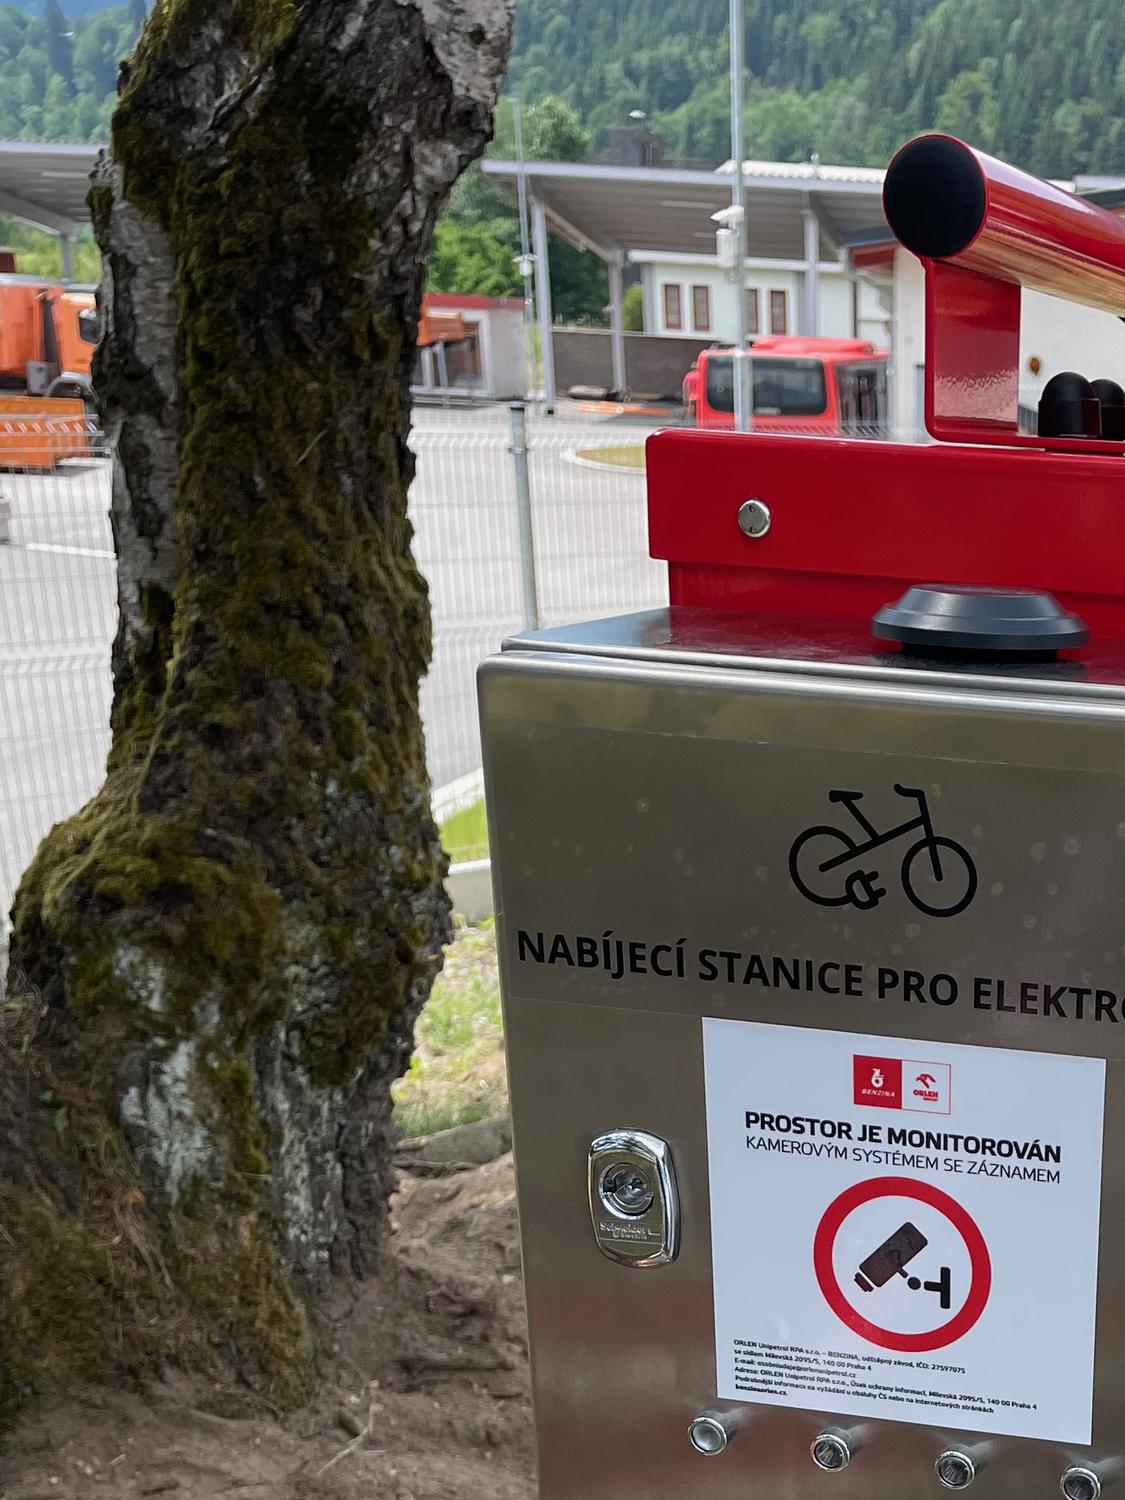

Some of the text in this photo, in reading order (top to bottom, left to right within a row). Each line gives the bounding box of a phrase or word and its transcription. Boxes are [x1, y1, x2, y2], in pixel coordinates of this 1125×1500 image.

[517, 929, 685, 980] NABÍJECÍ
[698, 949, 864, 997] STANICE
[877, 967, 959, 1007] PRO
[861, 1088, 896, 1098] BENZINA
[913, 1089, 938, 1098] ORLEN
[745, 1110, 1062, 1164] PROSTOR JE MONITOROVÁN
[746, 1135, 1060, 1184] KAMEROVÝM SYSTÉMEM SE ZÁZNAMEM
